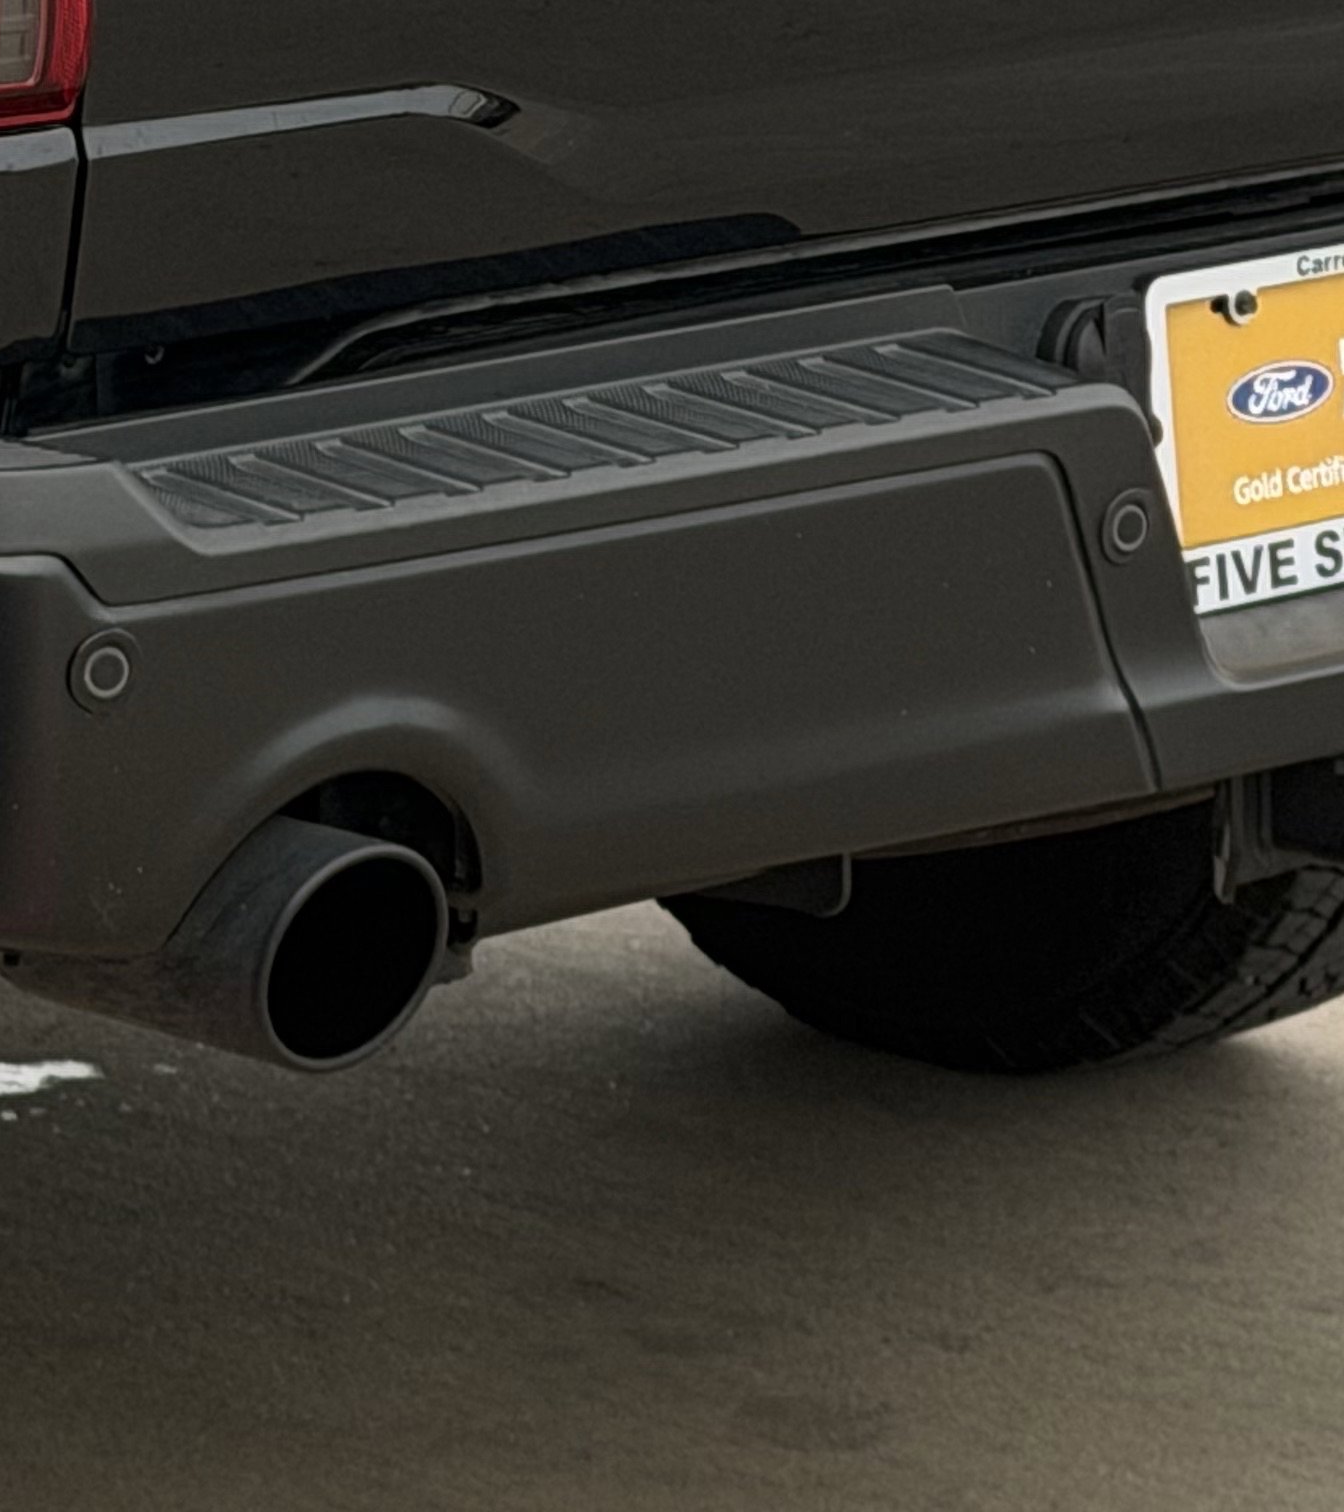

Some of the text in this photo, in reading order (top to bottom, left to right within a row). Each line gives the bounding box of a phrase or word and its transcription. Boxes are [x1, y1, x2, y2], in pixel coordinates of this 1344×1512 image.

[1248, 370, 1315, 415] Ford
[1233, 468, 1283, 506] Gold
[1187, 539, 1299, 607] FIVE
